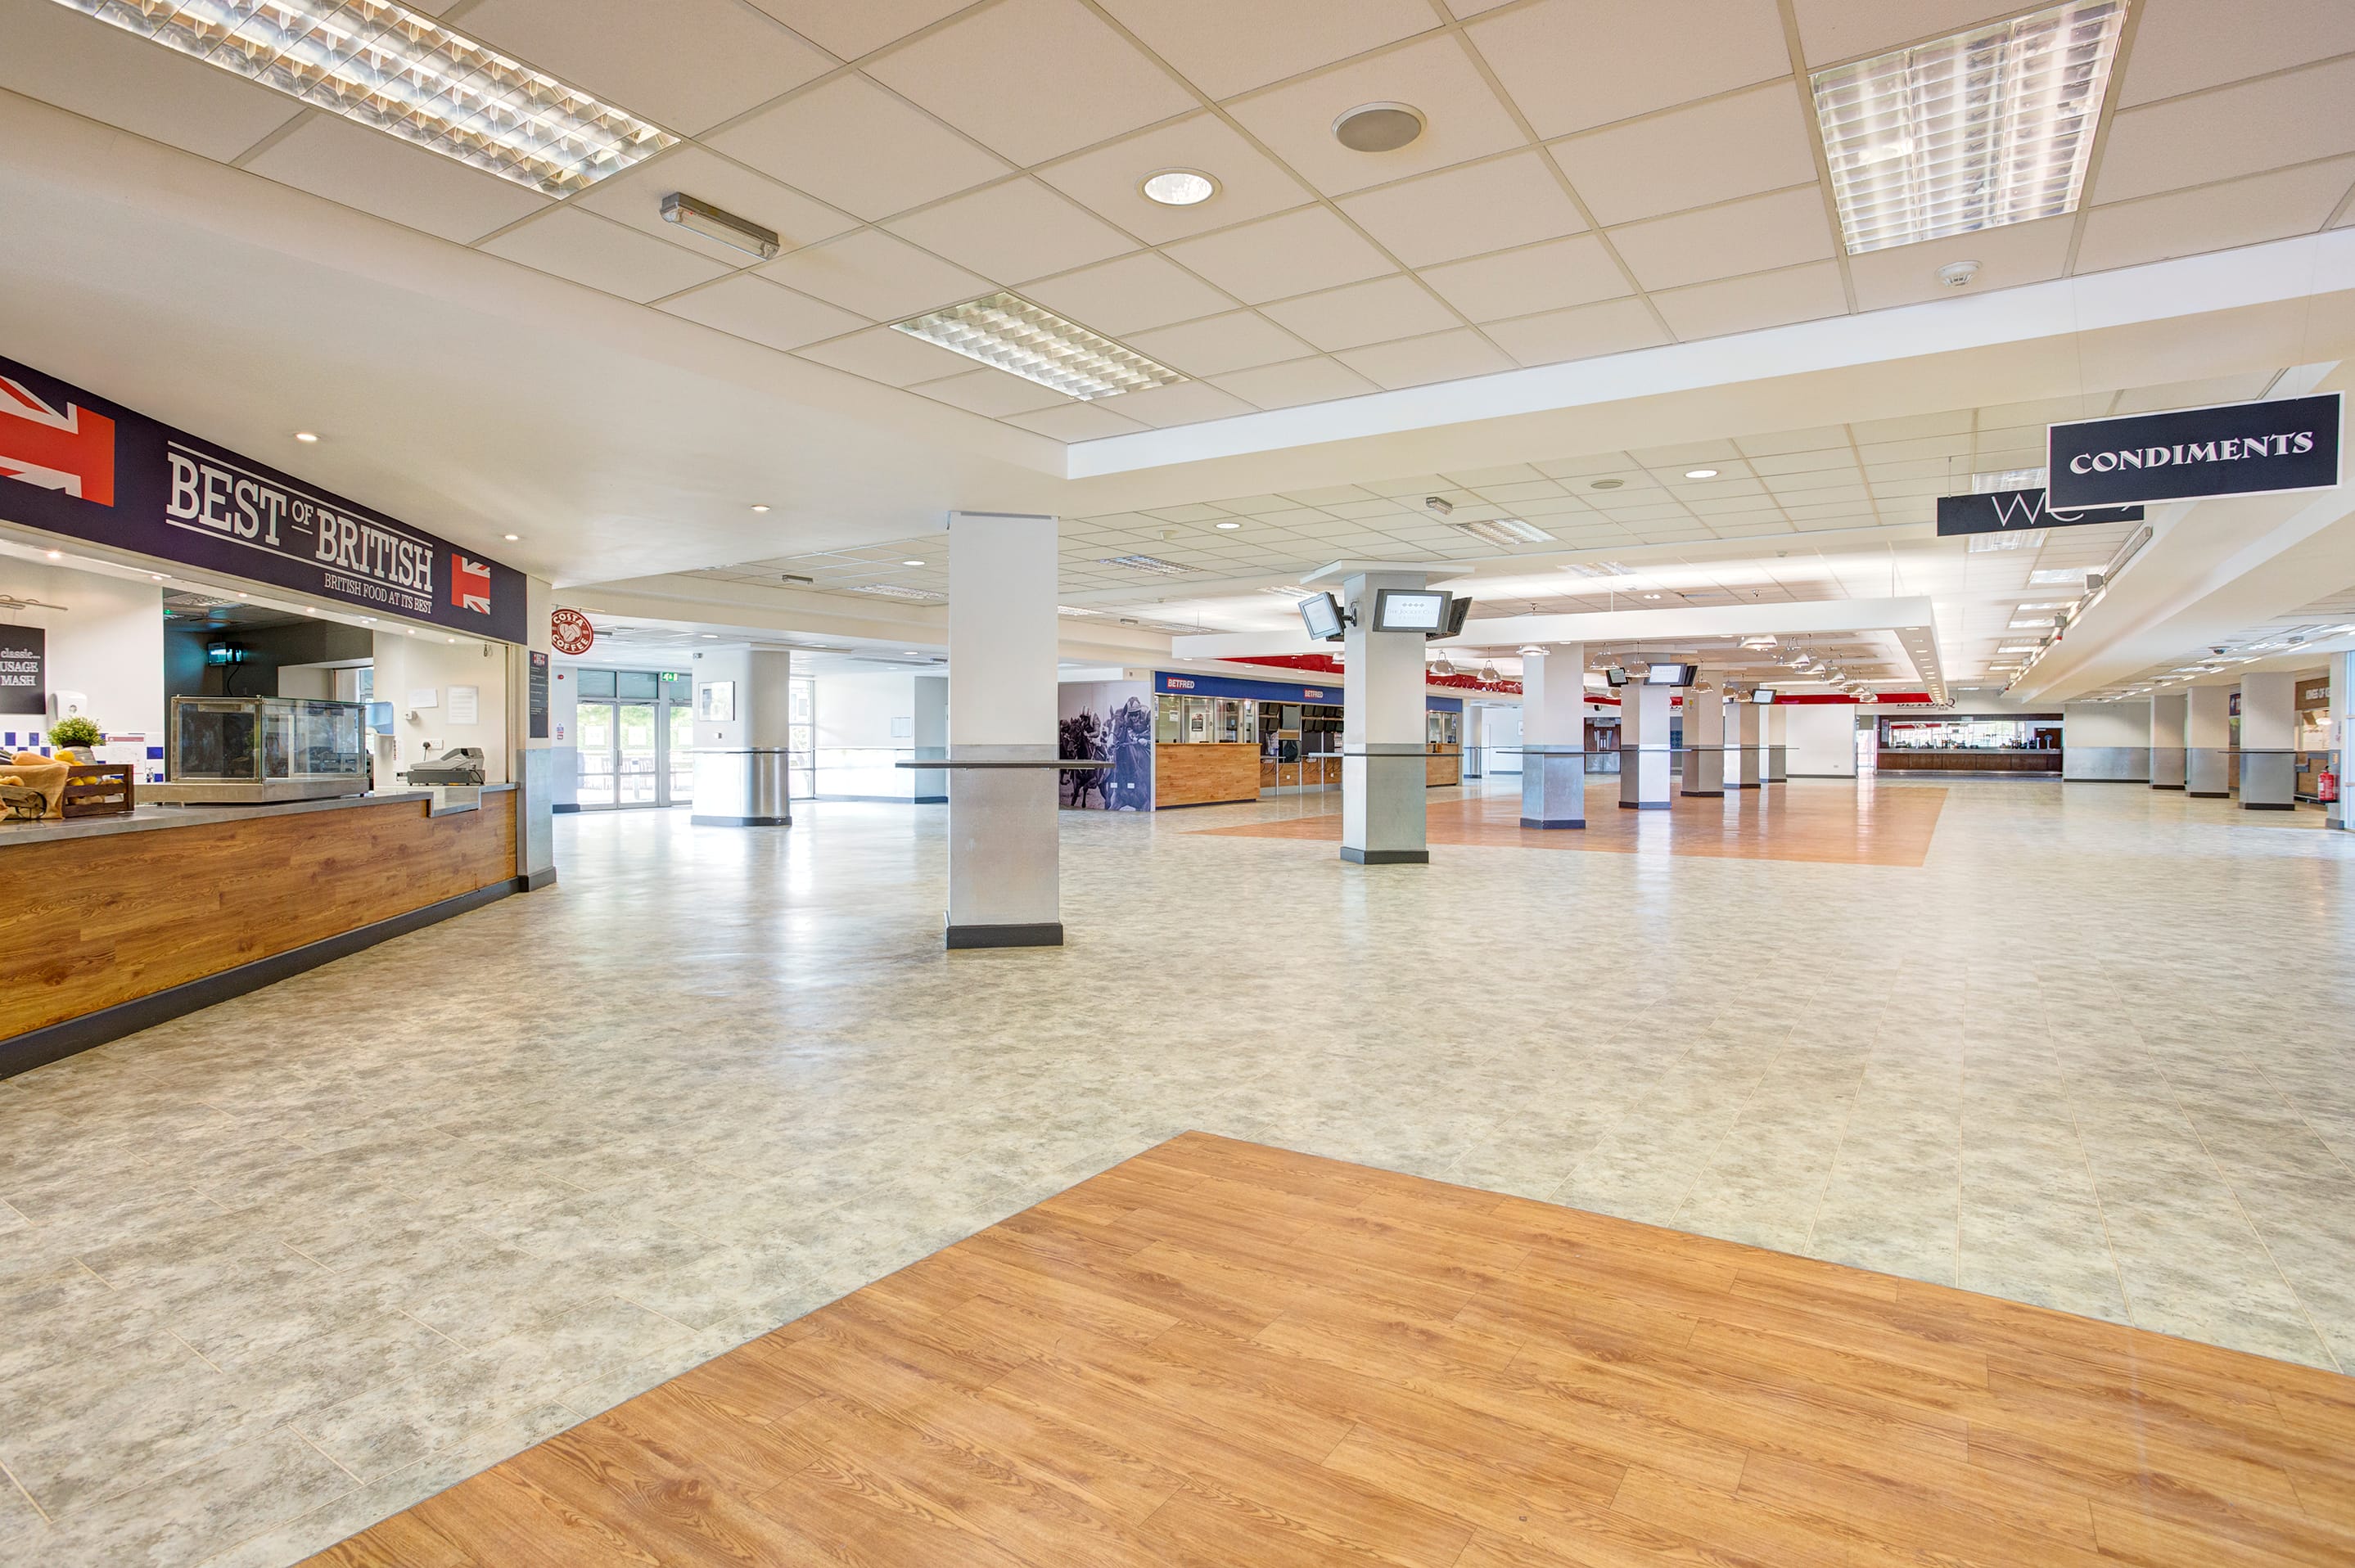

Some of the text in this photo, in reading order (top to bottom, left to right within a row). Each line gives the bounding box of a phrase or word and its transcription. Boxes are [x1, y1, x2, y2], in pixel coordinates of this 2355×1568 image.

[2069, 431, 2313, 475] CONDIMENTS
[166, 451, 433, 593] BEST OF BRITISH
[1992, 491, 2085, 527] W
[324, 572, 432, 614] BRITISH FOOD AT ITS BEST
[553, 613, 584, 627] COSTA
[553, 634, 589, 651] COFFEE
[1, 675, 37, 687] MASH
[1167, 678, 1195, 689] BETFRED
